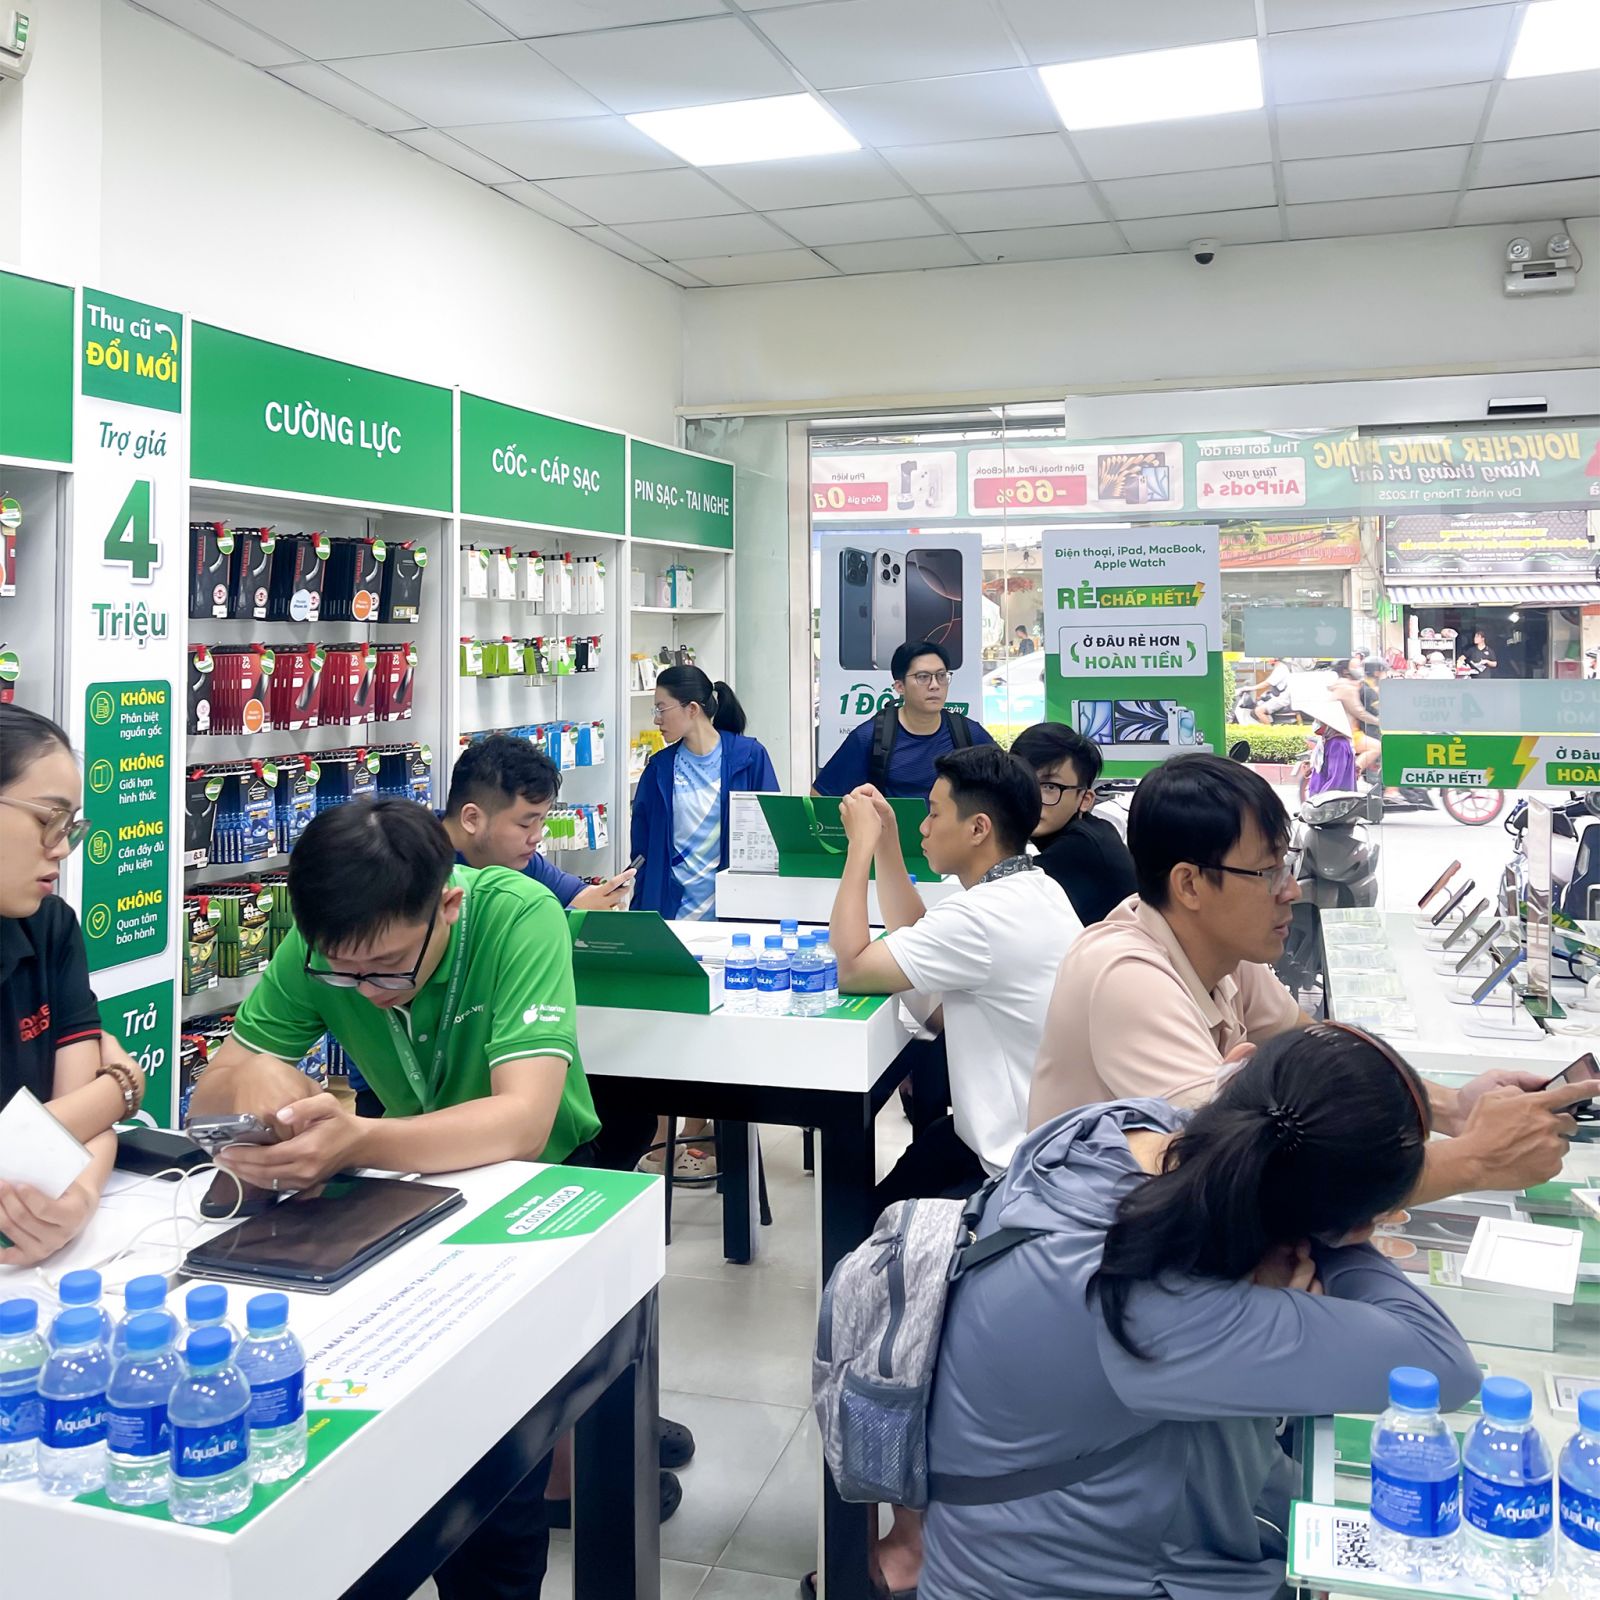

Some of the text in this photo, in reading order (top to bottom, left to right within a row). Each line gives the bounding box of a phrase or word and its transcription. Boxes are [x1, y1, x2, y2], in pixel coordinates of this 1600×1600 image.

[86, 303, 151, 340] Thu cũ
[86, 338, 177, 384] ĐỔI MỚI
[264, 400, 402, 459] CƯỜNG LỰC
[99, 421, 167, 459] Trợ giá
[491, 443, 527, 477] CỐC
[540, 456, 570, 486] CÁP
[572, 468, 600, 496] SẠC
[634, 479, 654, 501] PIN
[656, 485, 678, 510] SẠC
[685, 490, 701, 511] TAI
[703, 496, 729, 516] NGHE
[103, 479, 159, 579] 4
[1055, 548, 1080, 560] Điện
[1083, 547, 1115, 560] thoại,
[1117, 545, 1146, 556] iPad,
[1149, 543, 1206, 555] MacBook,
[1094, 558, 1166, 571] Apple Watch
[1057, 580, 1191, 610] RẺ CHẤP HẾT!
[91, 601, 166, 645] Triệu
[1083, 633, 1180, 648] Ở ĐÂU RẺ HƠN
[1085, 650, 1183, 669] HOÀN TIỀN
[120, 688, 165, 706] KHÔNG
[839, 693, 850, 715] 1
[120, 711, 160, 725] Phân biệt
[120, 725, 163, 741] nguồn gốc
[1426, 737, 1468, 766] RẺ
[1556, 746, 1600, 761] Ở Đâu
[119, 752, 165, 772] KHÔNG
[119, 778, 154, 790] Giới hạn
[1405, 770, 1482, 784] CHẤP HẾT!
[119, 790, 157, 805] hình thức
[118, 820, 164, 841] KHÔNG
[118, 846, 135, 859] Cần
[118, 859, 153, 876] phụ kiện
[117, 890, 162, 912] KHÔNG
[116, 912, 158, 931] Quan tâm
[116, 927, 156, 945] bảo hành
[122, 1002, 158, 1037] Trả
[128, 1044, 165, 1077] óp
[183, 1439, 238, 1461] AquaLife
